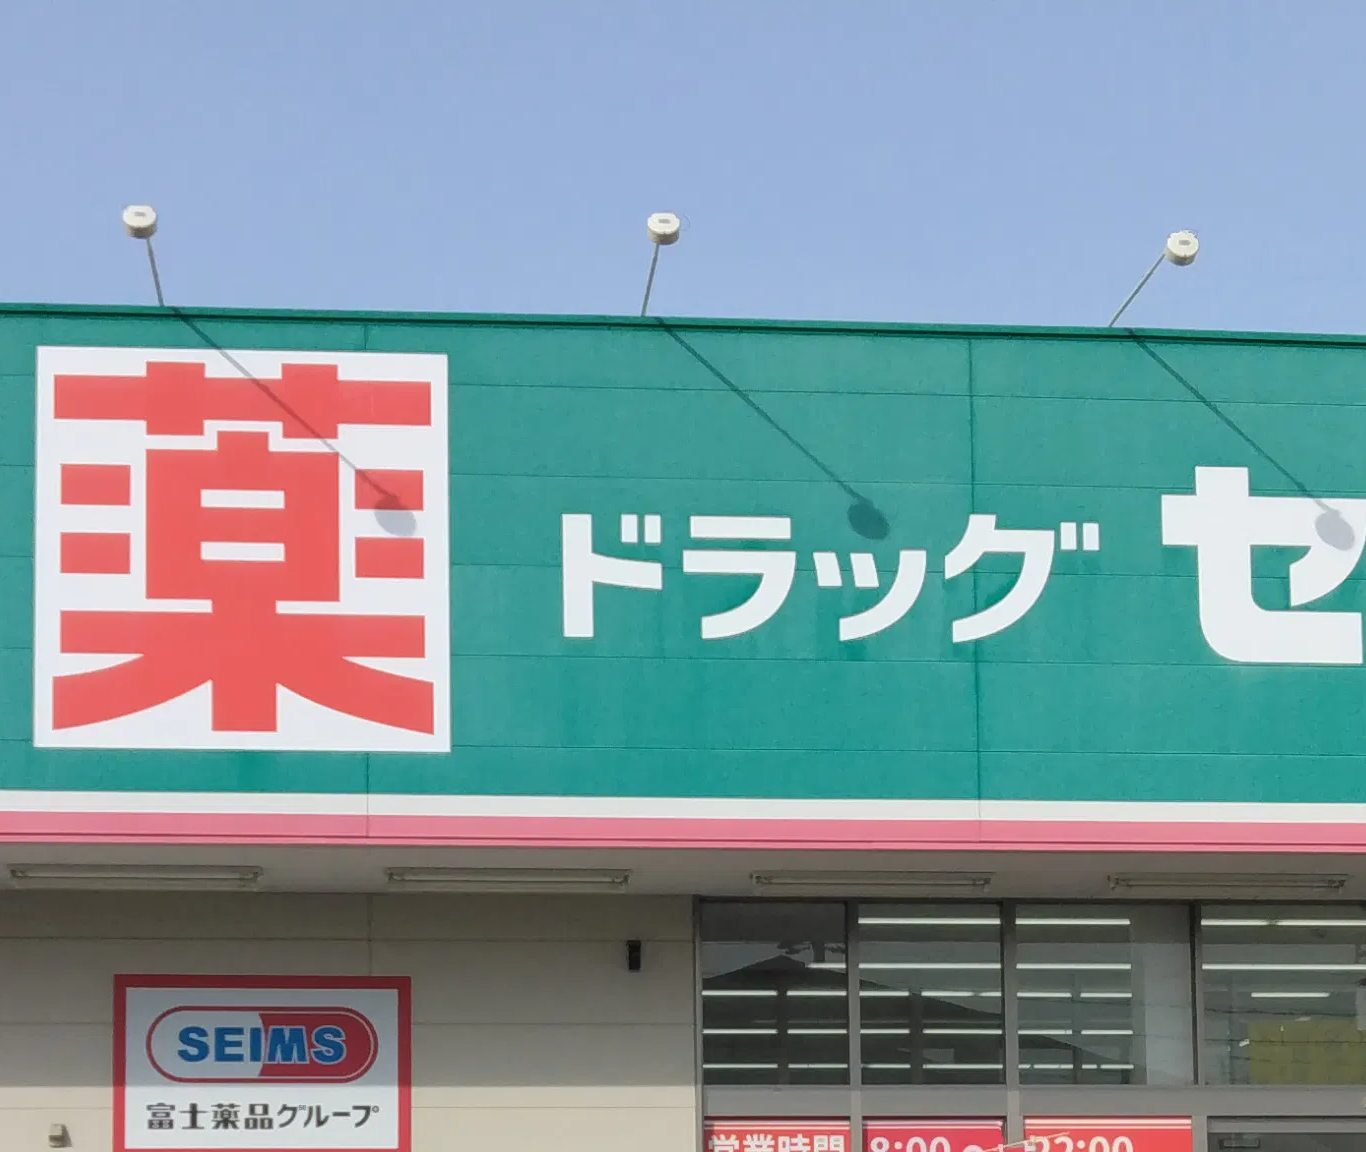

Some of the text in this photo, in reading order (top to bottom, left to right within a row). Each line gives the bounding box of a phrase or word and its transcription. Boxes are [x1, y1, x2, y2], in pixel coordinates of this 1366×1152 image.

[52, 362, 434, 736] 薬
[561, 513, 1100, 643] ドラッグ
[176, 1025, 348, 1065] SEIMS
[145, 1102, 380, 1130] 富士薬品グループ
